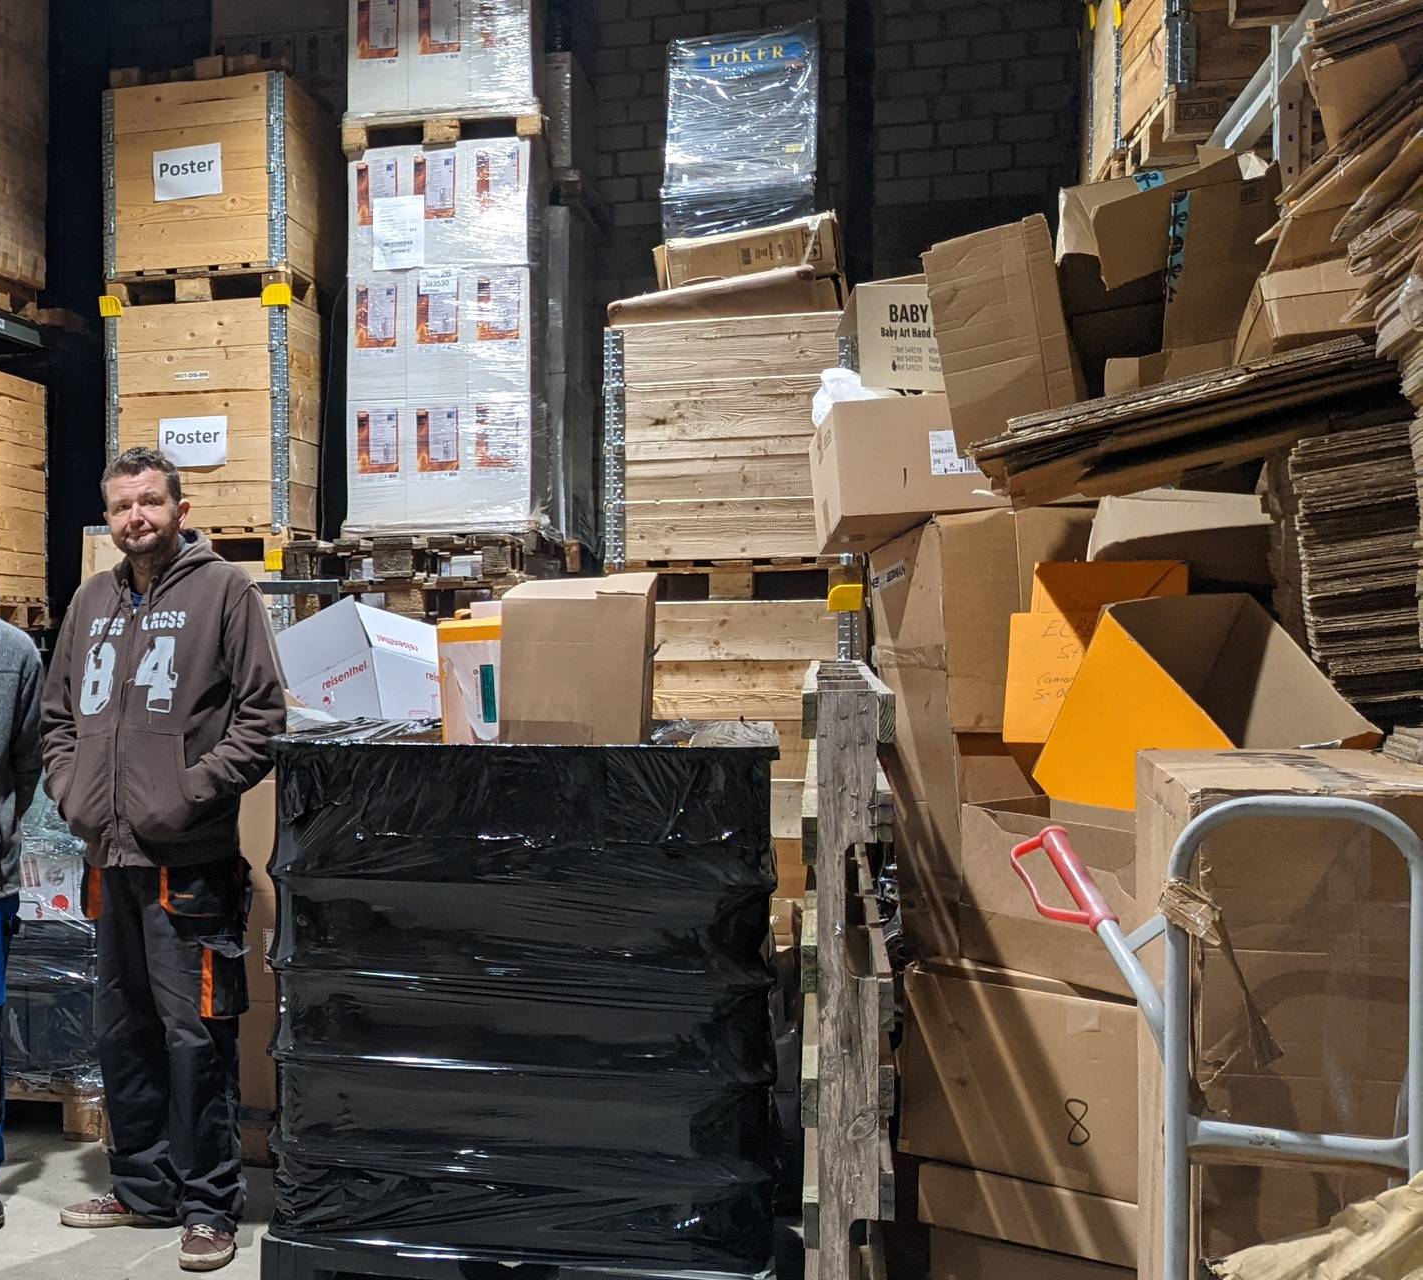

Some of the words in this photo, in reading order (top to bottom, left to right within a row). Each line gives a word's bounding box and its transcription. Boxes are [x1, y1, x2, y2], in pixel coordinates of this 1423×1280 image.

[710, 45, 785, 67] POKER
[159, 159, 215, 178] Poster
[889, 304, 929, 323] BABY
[880, 326, 898, 340] Baby
[899, 327, 911, 338] Art
[912, 327, 931, 338] Hand
[164, 430, 220, 445] Poster
[376, 634, 419, 652] reisenthel
[321, 660, 367, 691] reisenthel
[1063, 1097, 1092, 1148] 8
